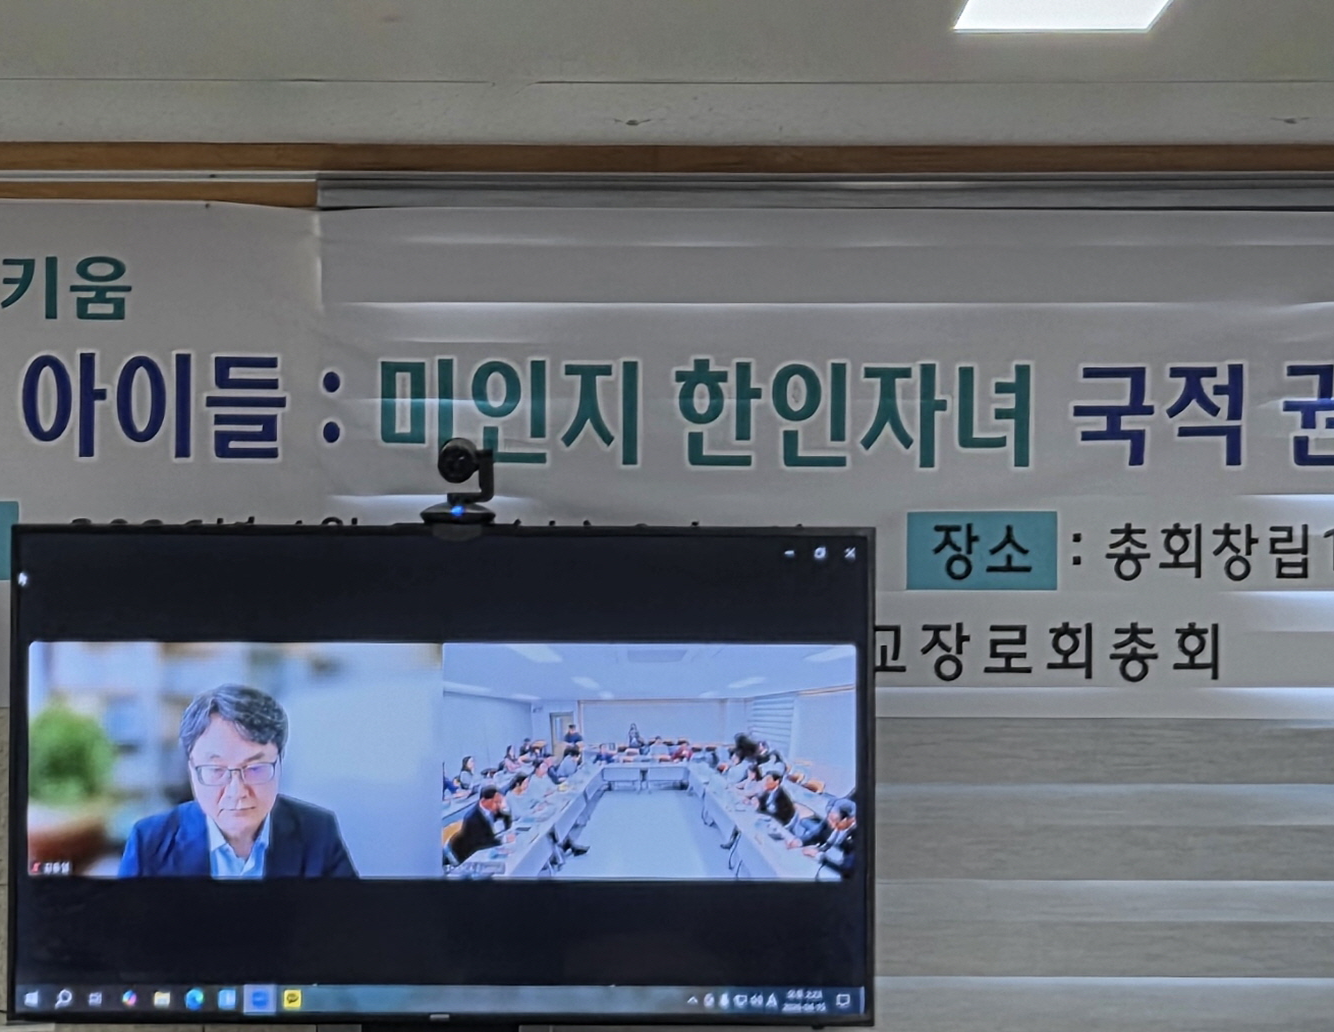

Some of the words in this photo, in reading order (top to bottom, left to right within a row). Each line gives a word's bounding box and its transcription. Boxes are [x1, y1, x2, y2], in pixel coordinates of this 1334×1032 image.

[23, 351, 288, 458] 아이들
[379, 357, 638, 465] 미인지
[675, 358, 1031, 468] 한인자녀
[1072, 361, 1244, 467] 국적
[932, 521, 1033, 582] 장소
